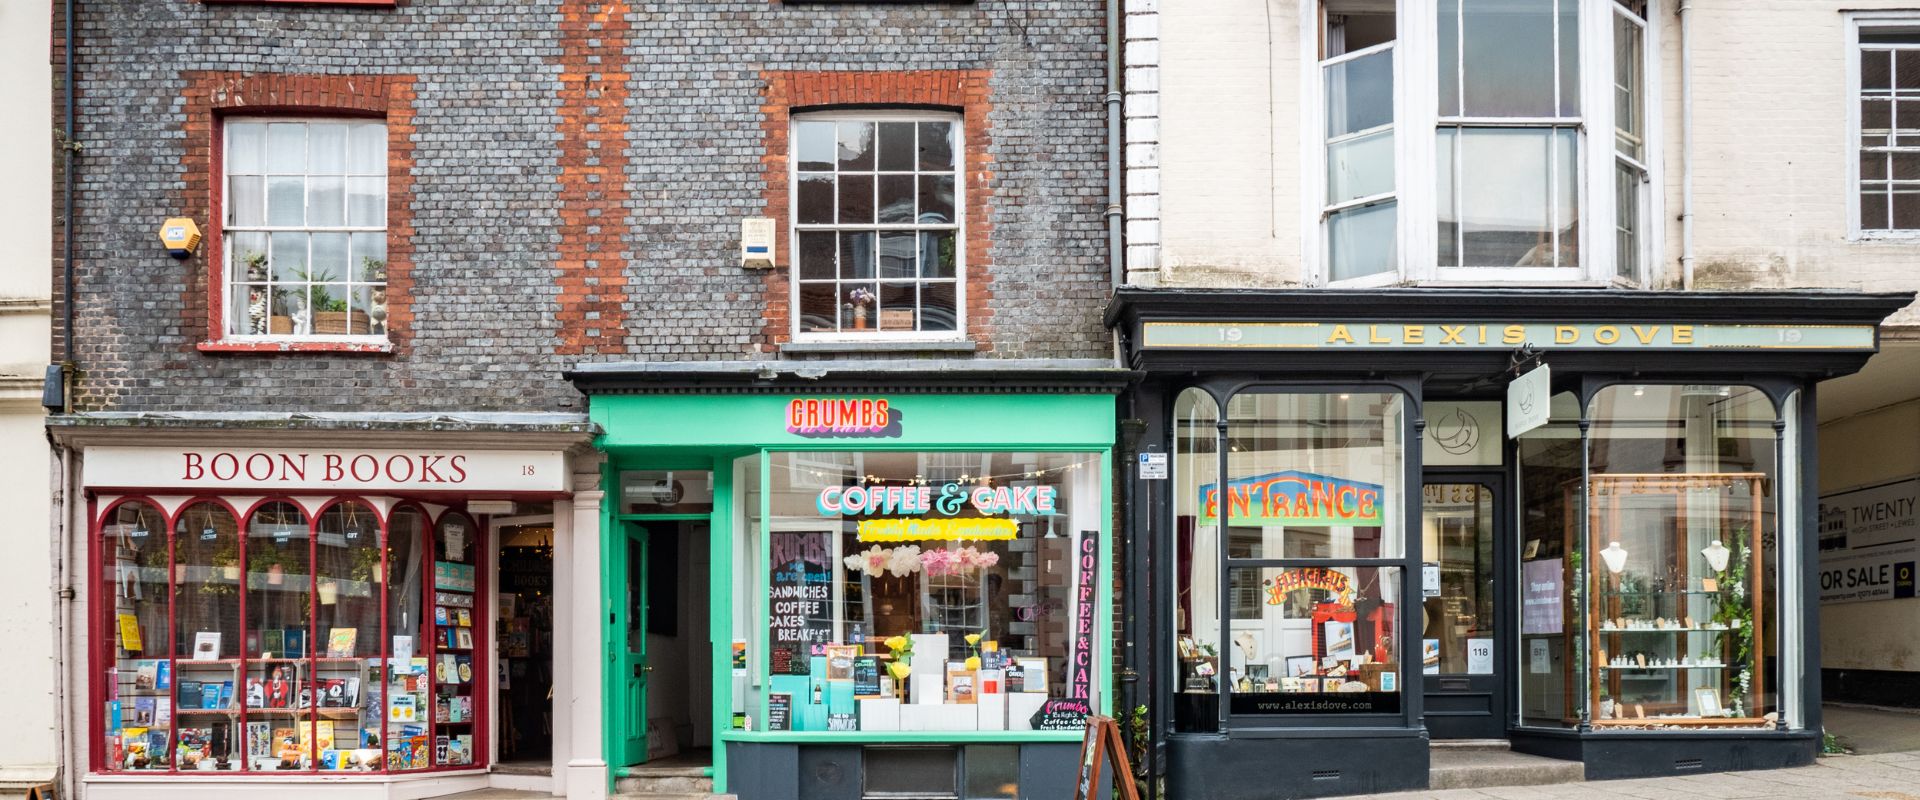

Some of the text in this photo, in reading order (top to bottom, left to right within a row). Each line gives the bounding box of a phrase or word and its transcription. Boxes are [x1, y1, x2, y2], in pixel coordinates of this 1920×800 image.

[1217, 327, 1243, 342] 19
[1325, 324, 1696, 344] ALEXIS DOVE
[1777, 328, 1803, 343] 19
[182, 452, 467, 484] BOON BOOKS
[522, 464, 535, 476] 18
[817, 482, 1057, 516] COFFEE & CAKE
[1205, 475, 1379, 519] ENTRANCE
[1852, 496, 1916, 524] TWENTY
[1869, 522, 1889, 532] STREET
[770, 533, 833, 570] RUMBS
[1819, 563, 1890, 591] OR SALE
[769, 585, 828, 599] SANDWICHES
[775, 601, 820, 615] COFFEE
[769, 615, 805, 628] CAKES
[778, 628, 831, 641] BREAKFAST
[1473, 648, 1488, 657] 118
[1257, 700, 1372, 711] www.alexisdove.com
